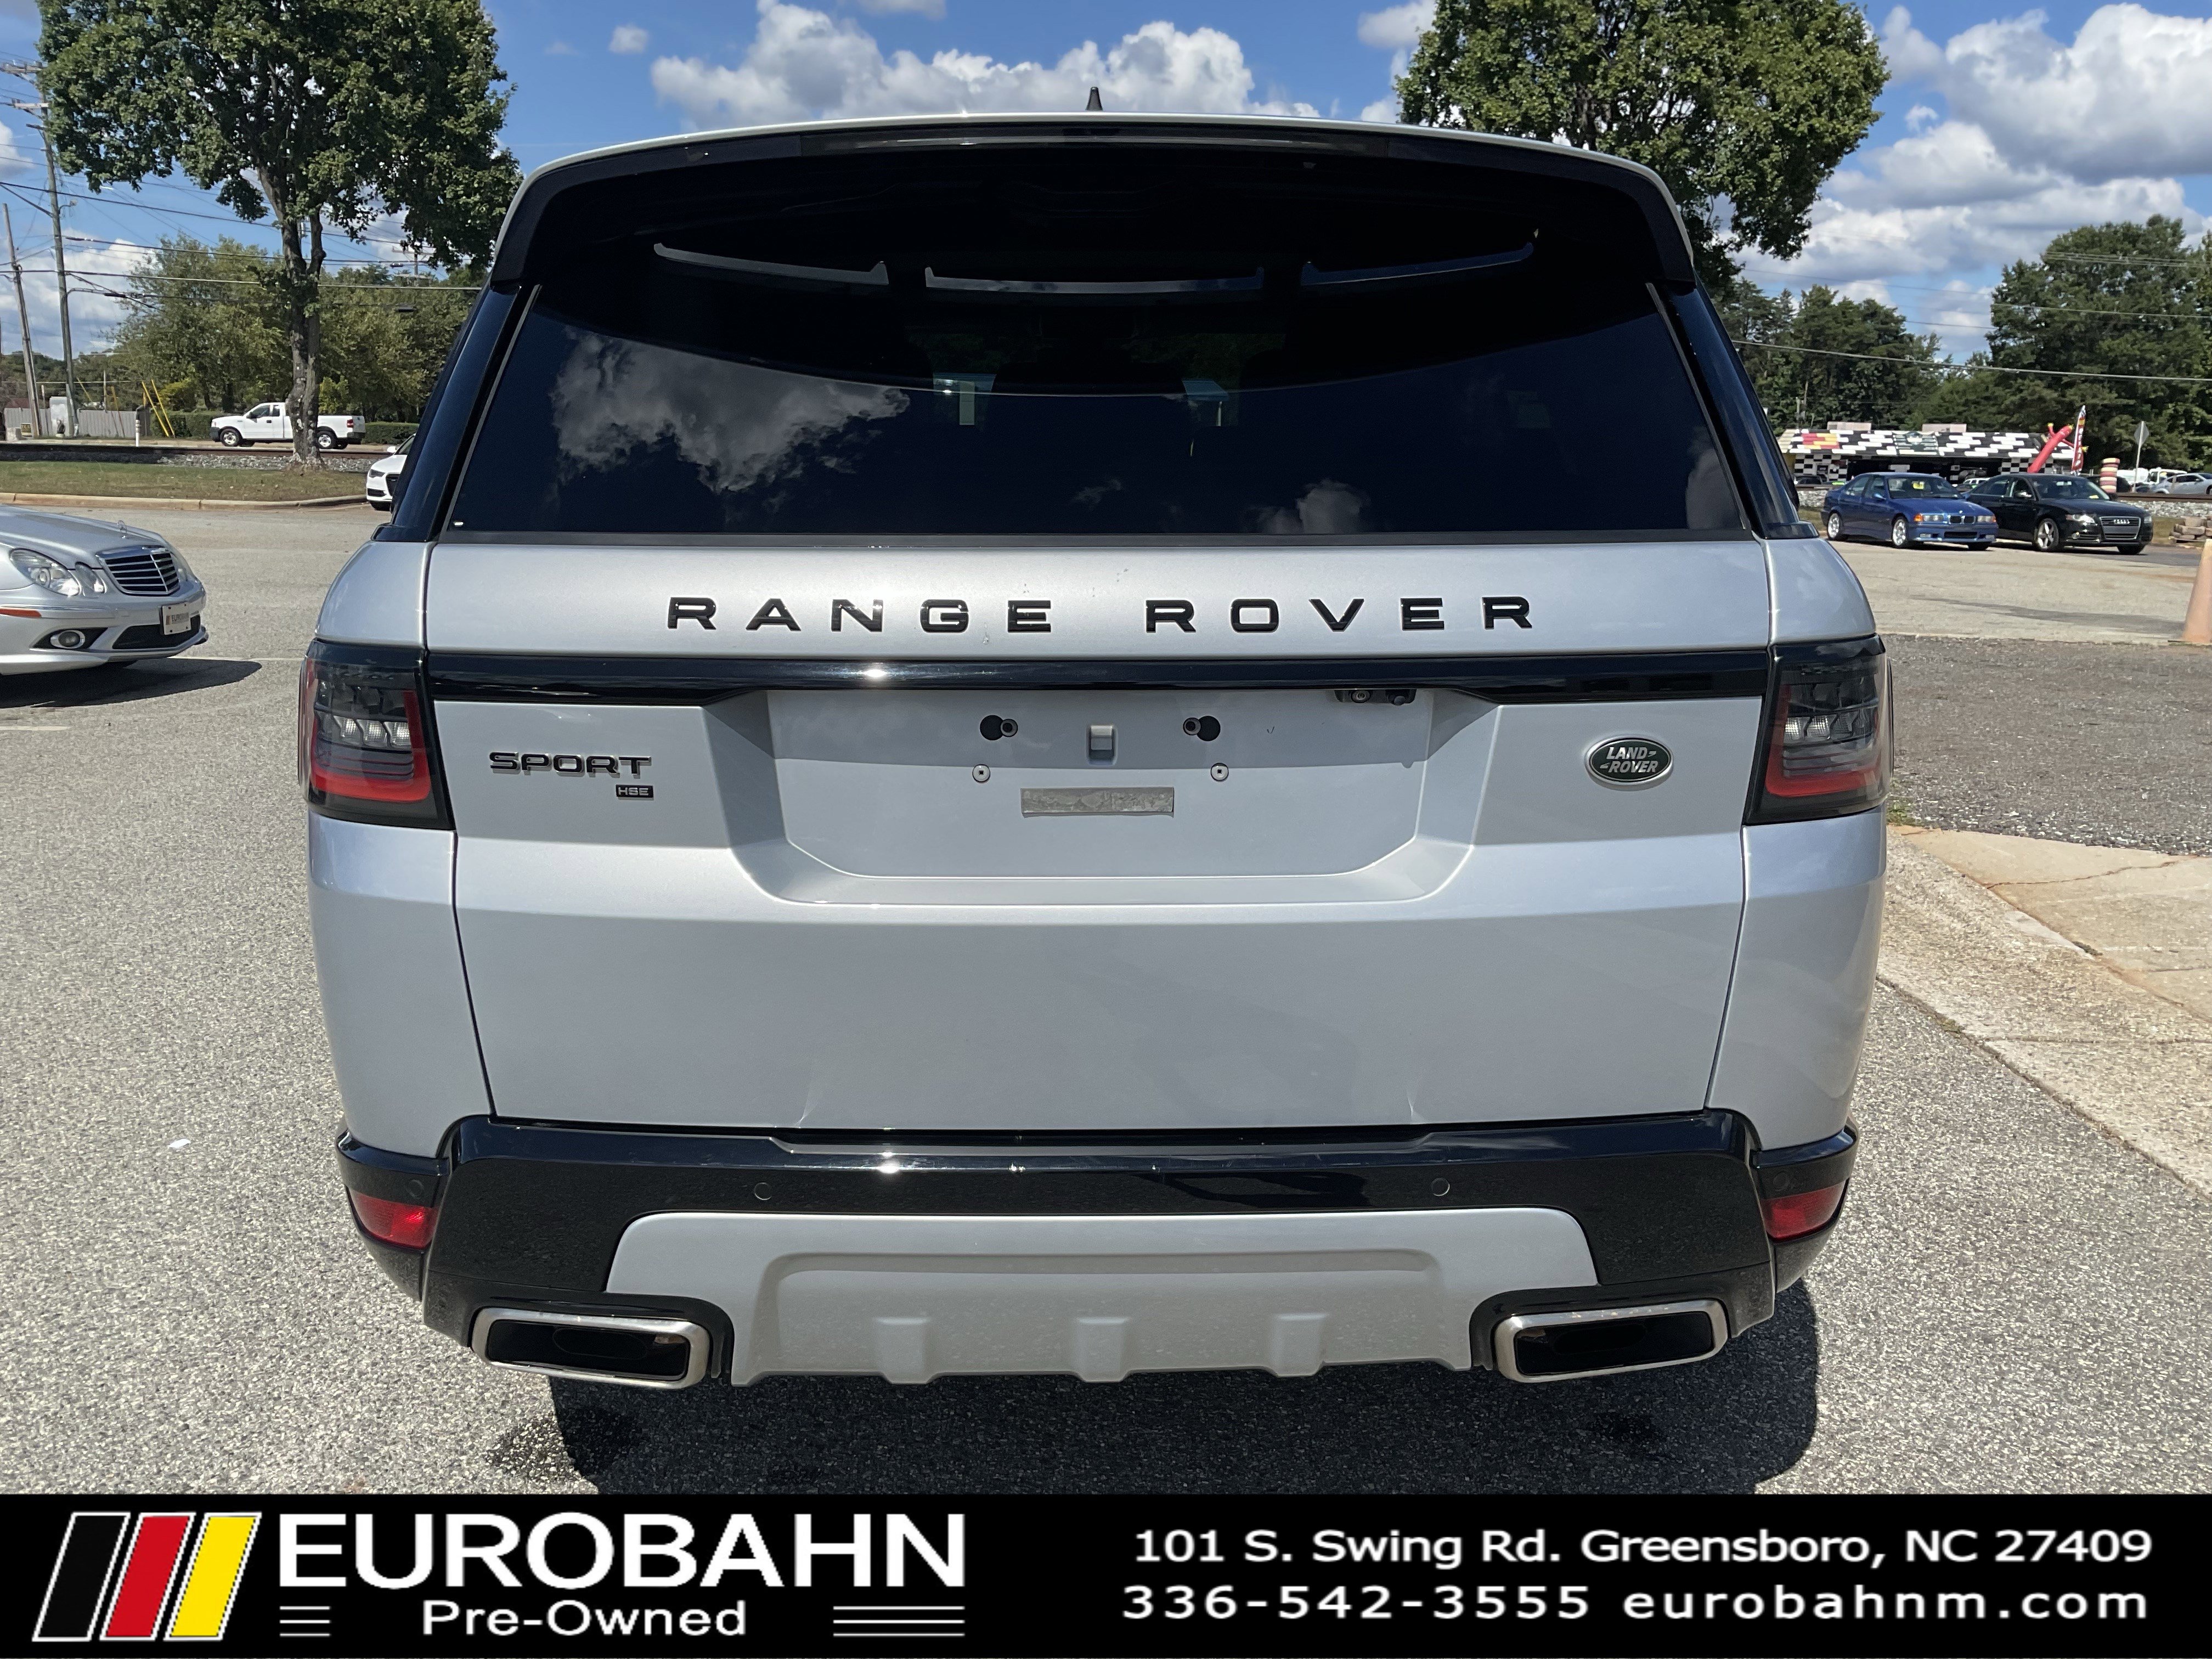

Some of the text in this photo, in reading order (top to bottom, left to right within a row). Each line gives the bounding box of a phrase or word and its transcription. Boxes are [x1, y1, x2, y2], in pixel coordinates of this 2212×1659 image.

[667, 596, 1532, 633] RANGE ROVER
[1606, 747, 1648, 760] LAND
[489, 752, 652, 777] SPORT
[1608, 760, 1658, 773] ROVER
[618, 787, 649, 796] HSE
